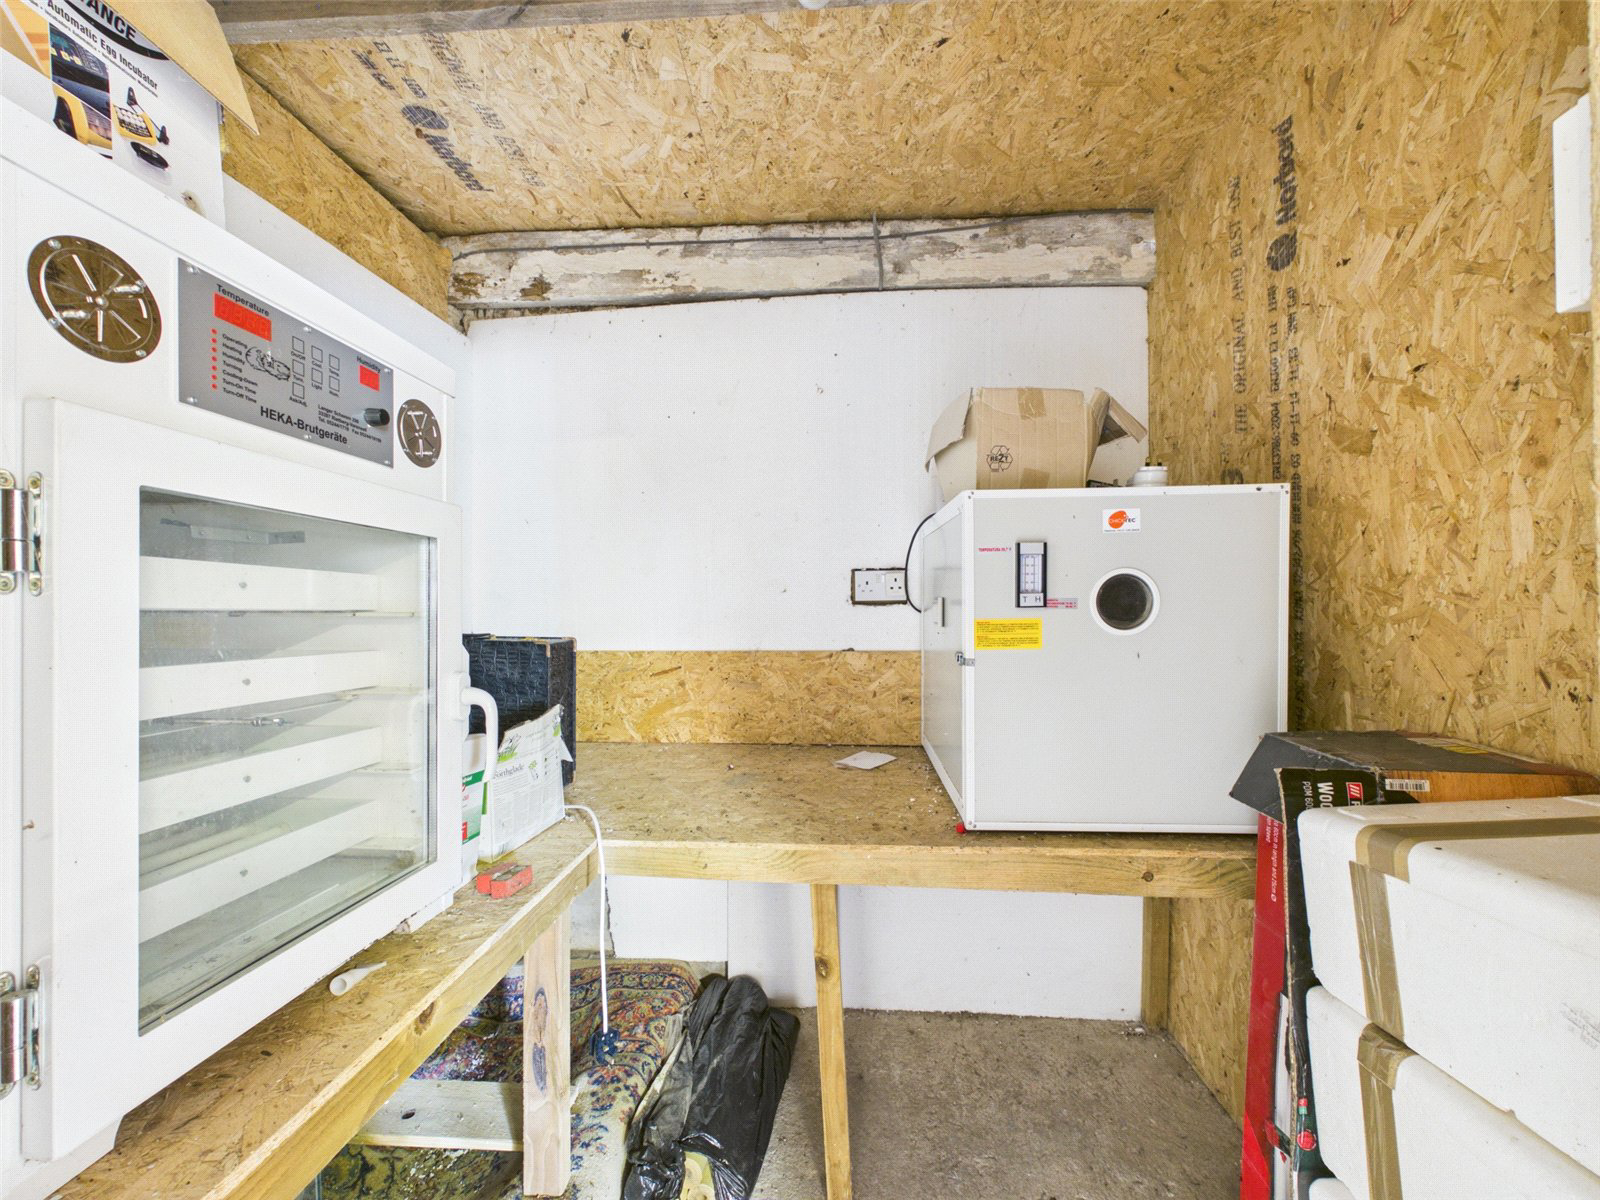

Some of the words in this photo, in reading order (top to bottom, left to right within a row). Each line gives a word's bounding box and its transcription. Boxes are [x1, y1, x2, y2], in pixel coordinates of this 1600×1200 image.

[80, 0, 136, 39] ANCE
[48, 0, 98, 43] Automatic
[101, 39, 117, 59] Egg
[119, 54, 158, 90] Incubator
[1271, 114, 1297, 226] Norbord
[1229, 221, 1243, 259] BEST
[216, 283, 270, 317] Temperature
[1231, 267, 1244, 302] AND
[356, 355, 381, 374] Humidity
[1232, 317, 1246, 393] ORIGINAL
[260, 405, 348, 444] HEKA-Brutgeräte
[1234, 403, 1247, 433] THE
[493, 762, 525, 778] orthglade
[1302, 781, 1314, 797] PDM
[1317, 782, 1335, 808] Woo
